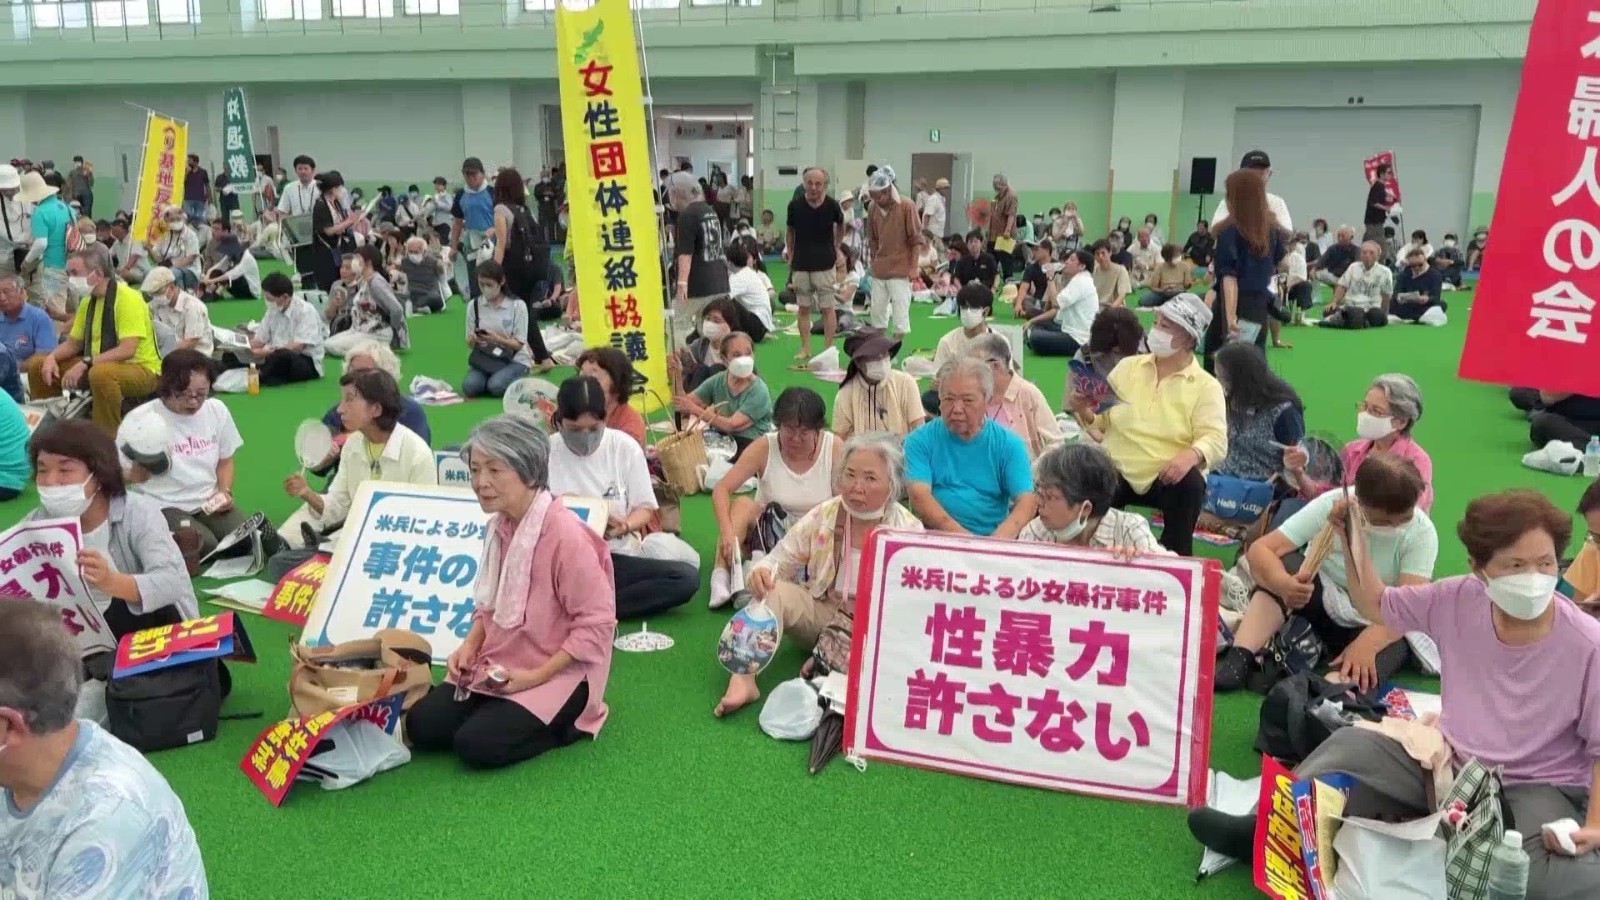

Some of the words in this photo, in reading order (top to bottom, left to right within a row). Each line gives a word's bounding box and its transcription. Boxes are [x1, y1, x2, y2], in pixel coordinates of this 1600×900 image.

[363, 541, 478, 588] 事件の
[274, 580, 319, 616] 事件
[901, 566, 1167, 615] 米兵による少女暴行事件
[925, 602, 1130, 687] 性暴力
[904, 668, 1150, 761] 許さない
